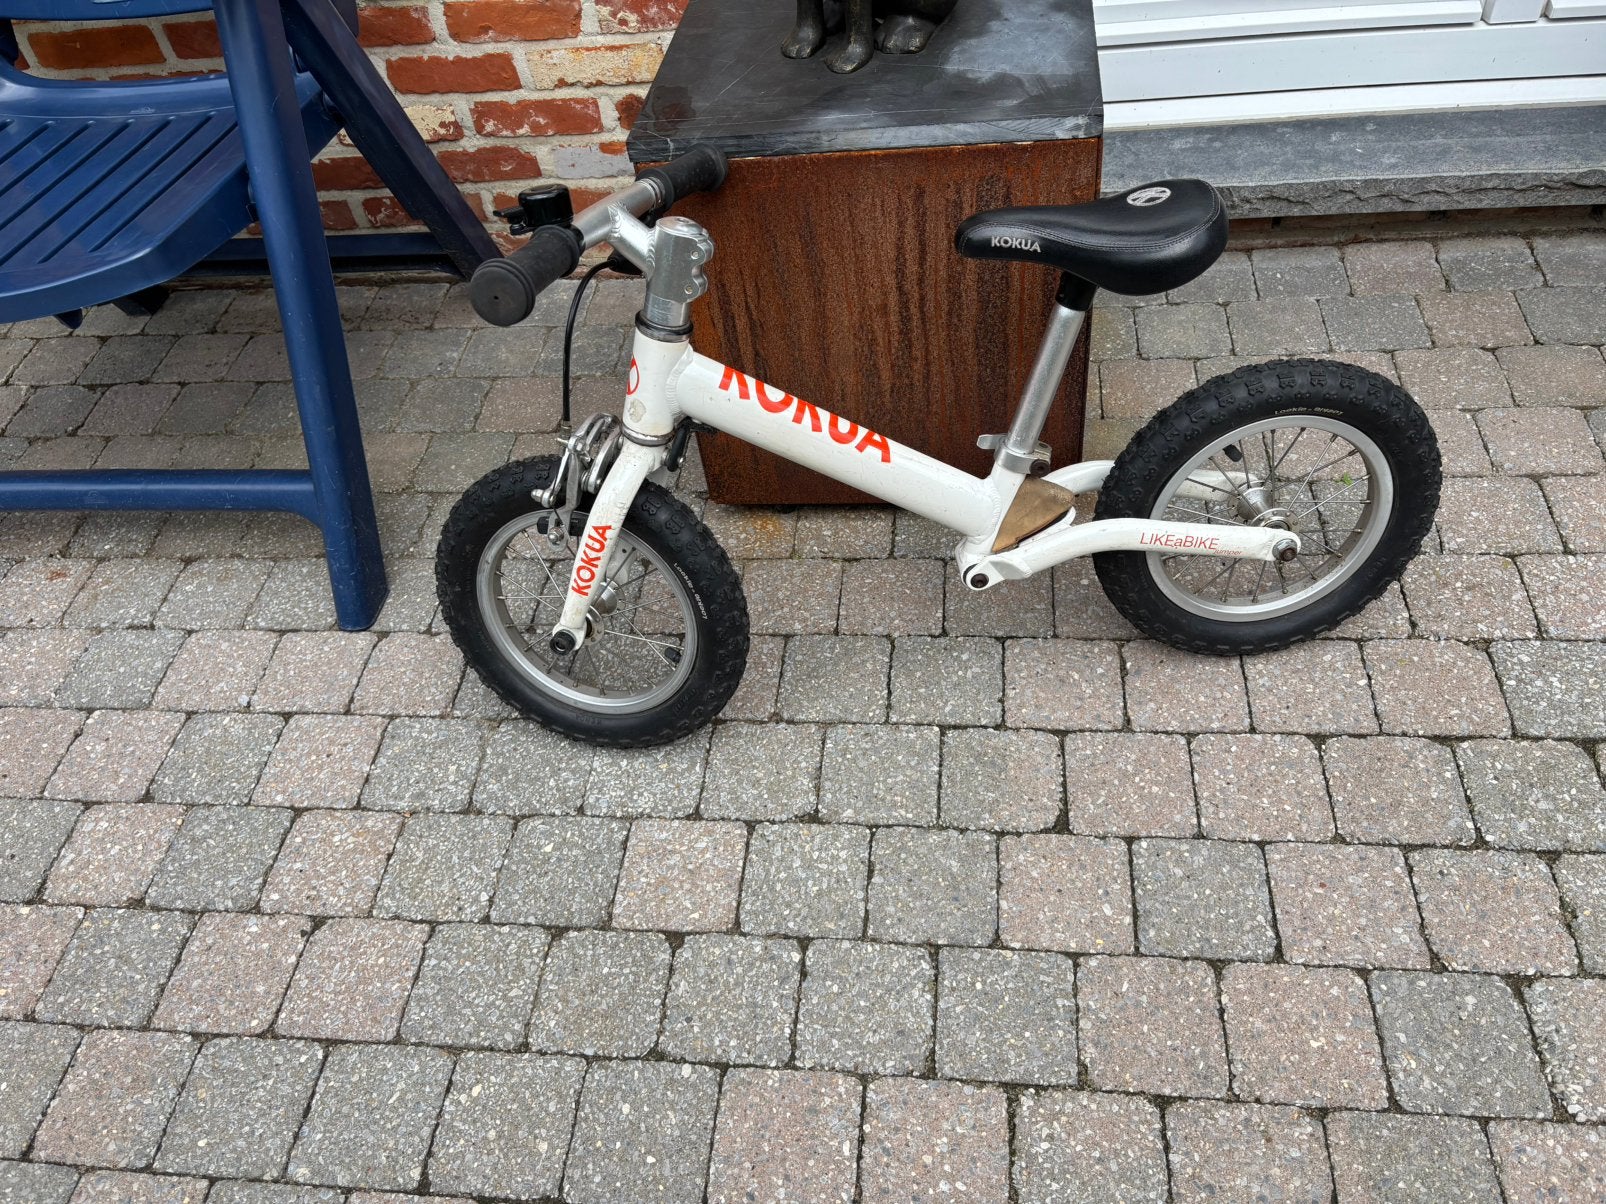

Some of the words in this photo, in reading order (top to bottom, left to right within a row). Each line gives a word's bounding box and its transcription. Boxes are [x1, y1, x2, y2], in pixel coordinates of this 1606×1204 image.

[991, 236, 1041, 253] KOKUA
[718, 365, 892, 464] KOKUA
[571, 524, 613, 597] KOKUA
[1139, 532, 1220, 550] LIKEaBIKE
